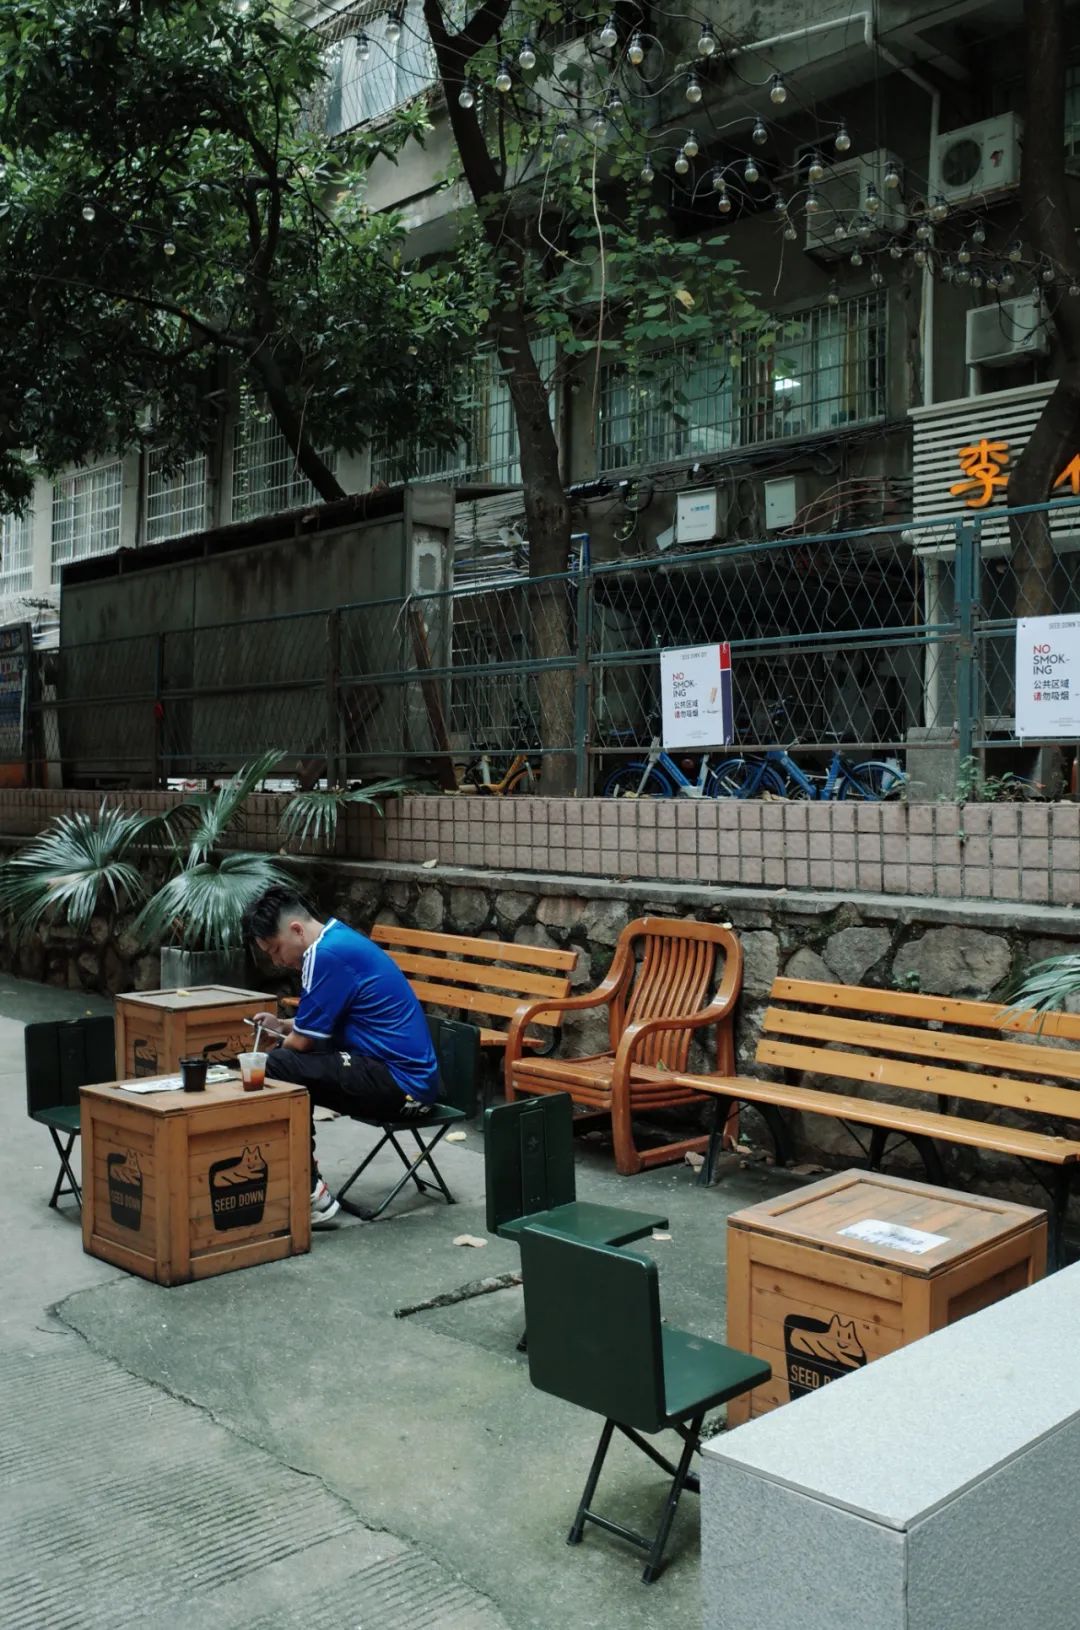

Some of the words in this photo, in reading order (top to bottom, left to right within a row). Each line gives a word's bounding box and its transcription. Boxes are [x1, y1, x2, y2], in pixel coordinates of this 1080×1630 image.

[1033, 644, 1051, 654] NO
[1033, 654, 1071, 665] SMOK-
[1033, 665, 1052, 675] ING
[672, 672, 685, 681] NO
[1034, 679, 1069, 690] 公共区域
[673, 689, 687, 698] ING
[1033, 691, 1069, 701] 请勿吸烟
[214, 1196, 237, 1213] SEED
[238, 1189, 265, 1207] DOWN
[790, 1364, 820, 1389] SEED
